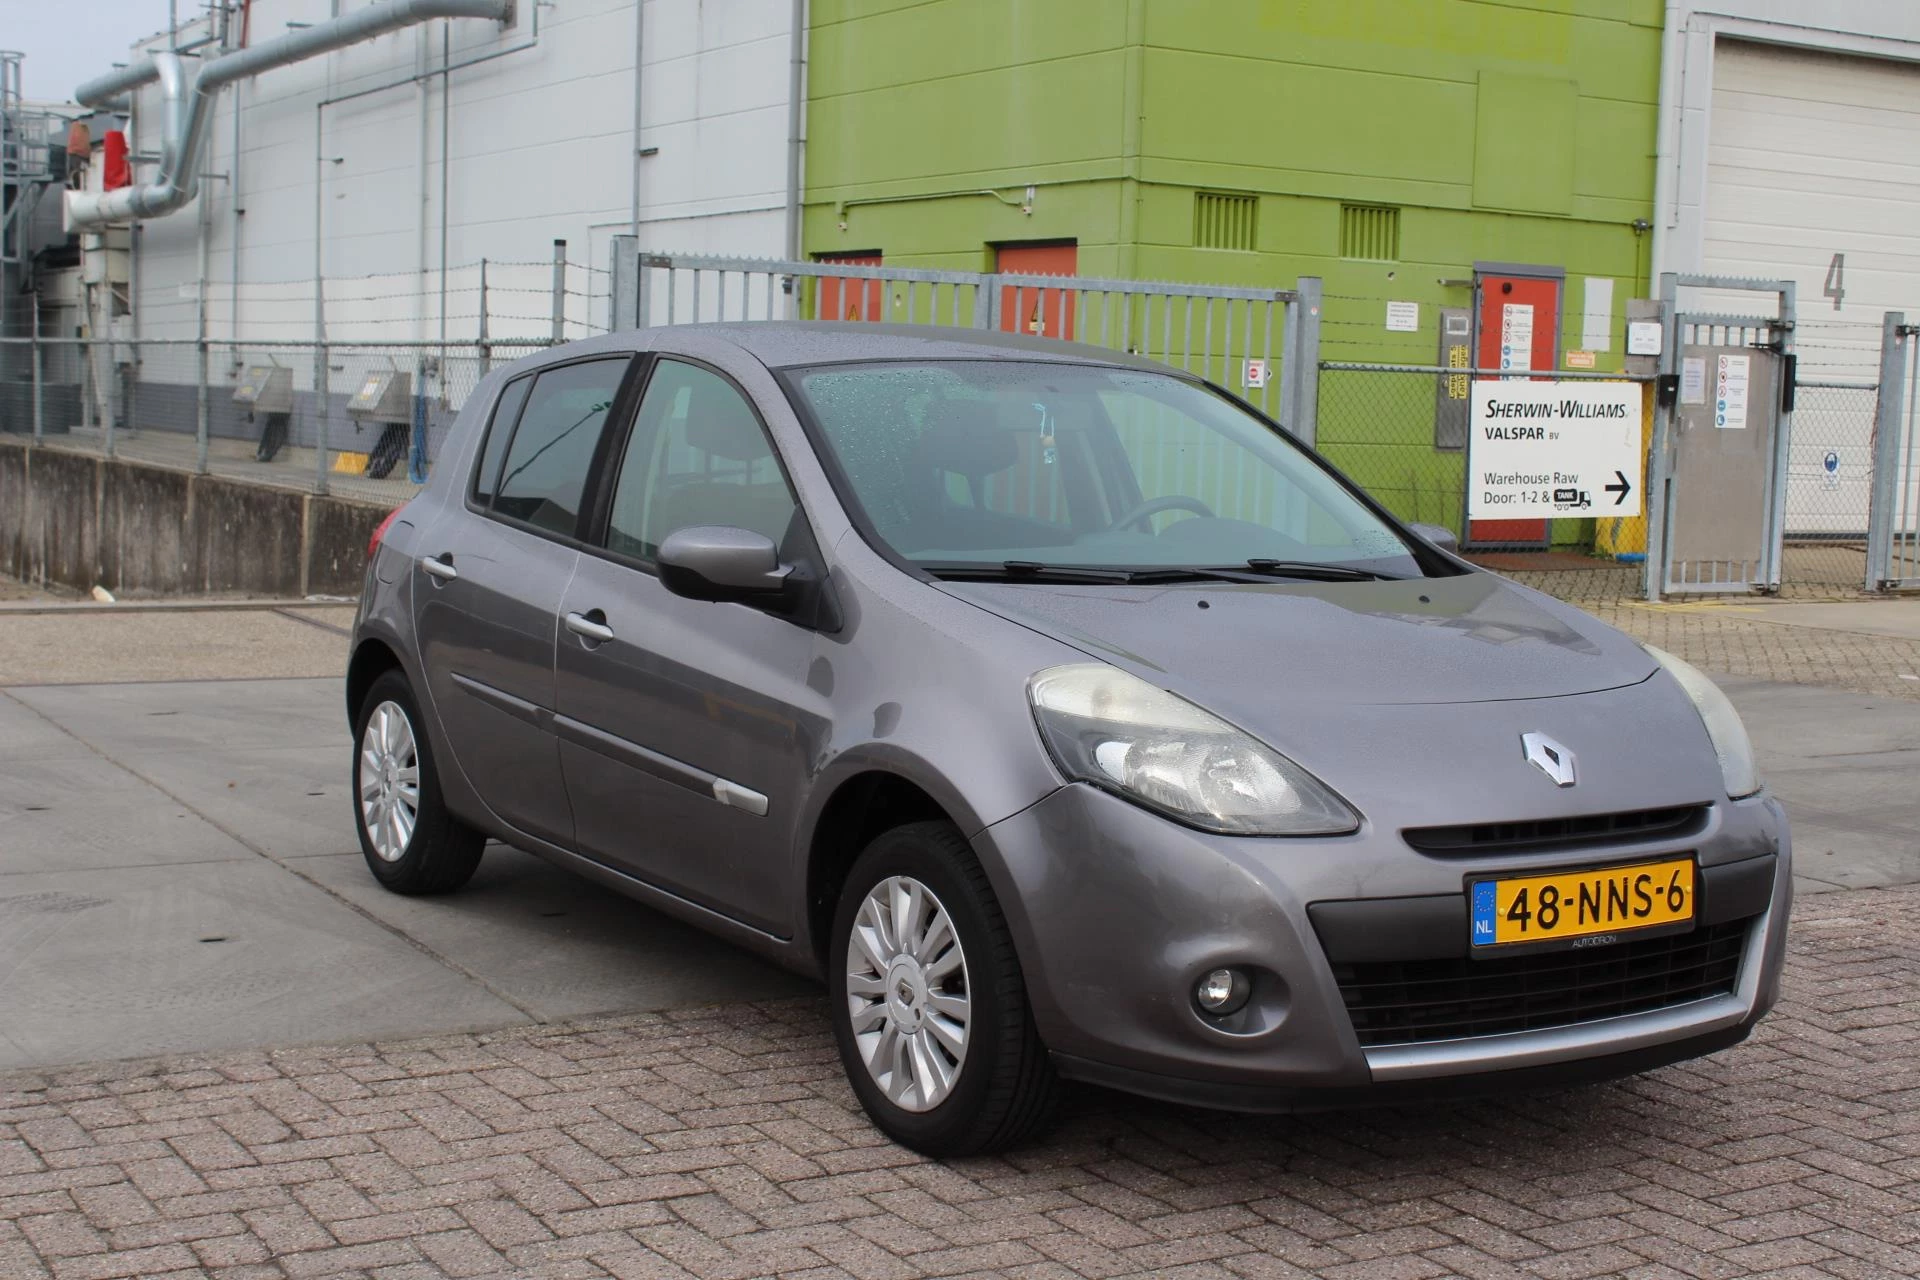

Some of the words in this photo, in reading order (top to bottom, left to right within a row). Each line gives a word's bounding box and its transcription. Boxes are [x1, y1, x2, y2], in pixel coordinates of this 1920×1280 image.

[1824, 253, 1845, 311] 4
[1458, 344, 1468, 398] Tankagen
[1485, 427, 1544, 440] VALSPAR
[1549, 432, 1560, 440] BV
[1484, 472, 1550, 485] Warehouse
[1553, 472, 1579, 484] Raw
[1484, 491, 1517, 504] Door:
[1521, 490, 1538, 503] 1-2
[1542, 491, 1550, 503] &
[1556, 491, 1575, 500] TANK
[1507, 869, 1685, 932] 48-NNS-6
[1475, 920, 1493, 934] NL
